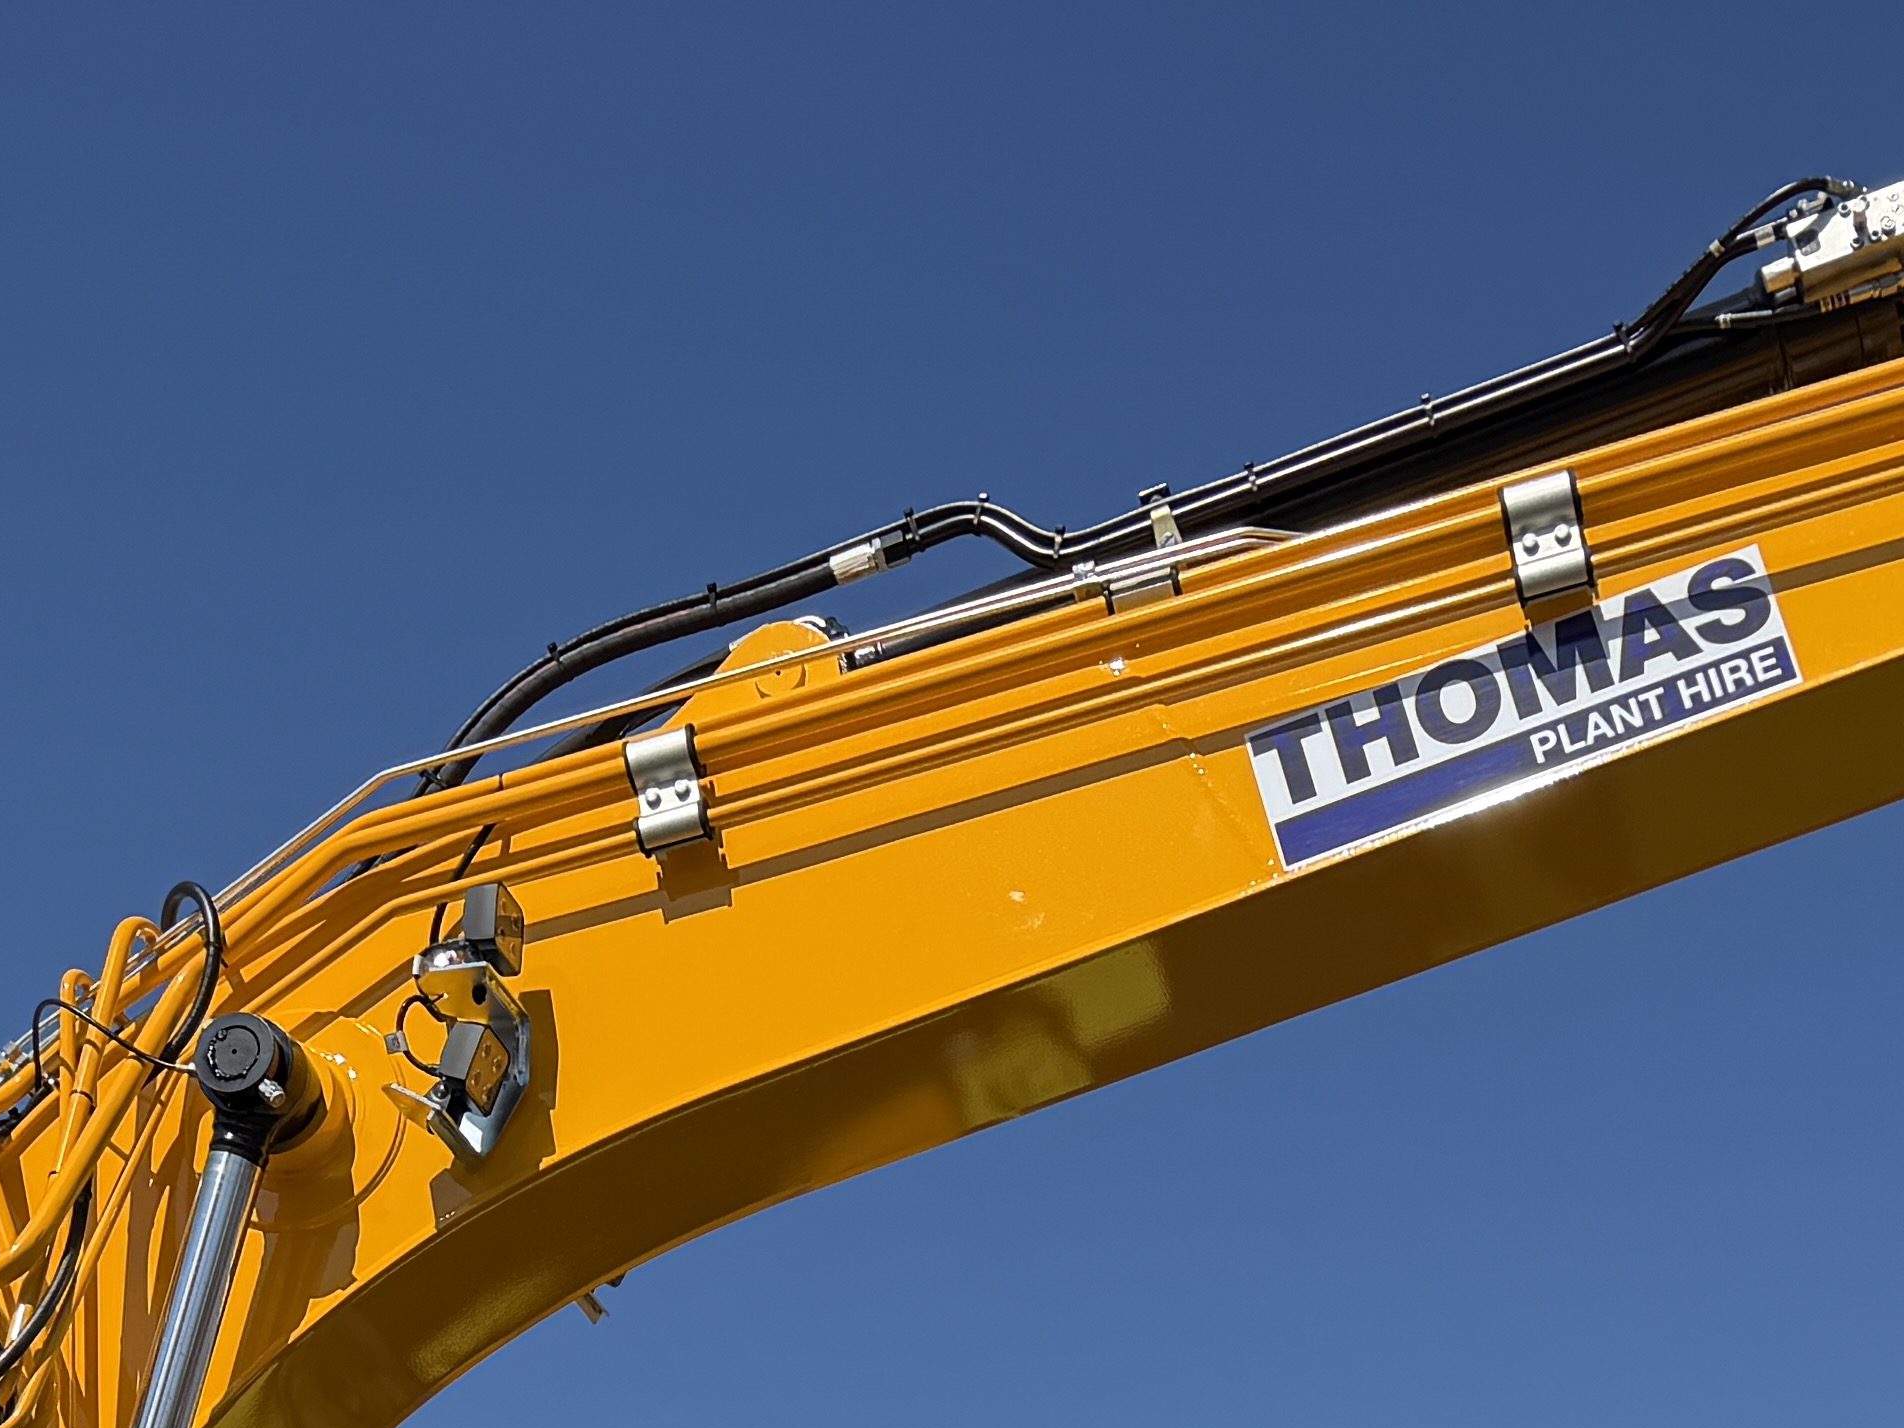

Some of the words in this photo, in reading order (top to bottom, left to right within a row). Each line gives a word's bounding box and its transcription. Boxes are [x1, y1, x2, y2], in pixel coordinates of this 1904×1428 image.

[1248, 557, 1772, 805] THOMAS
[1529, 687, 1669, 764] PLANT
[1677, 647, 1783, 711] HIRE
